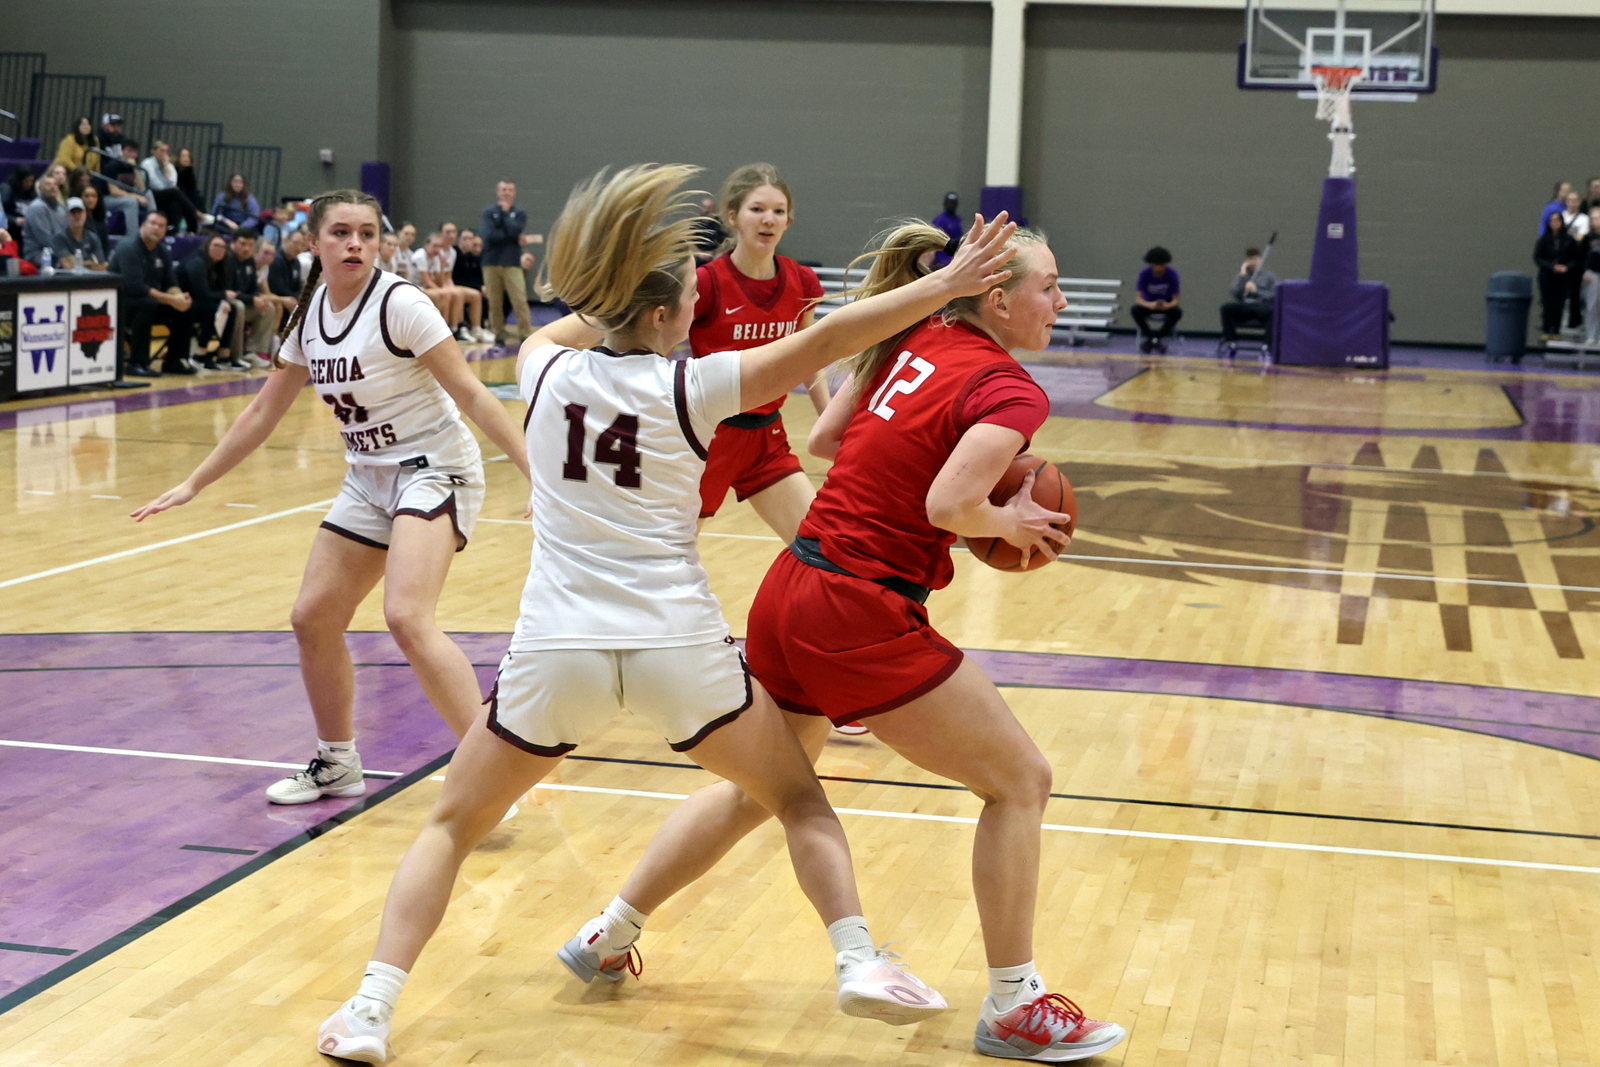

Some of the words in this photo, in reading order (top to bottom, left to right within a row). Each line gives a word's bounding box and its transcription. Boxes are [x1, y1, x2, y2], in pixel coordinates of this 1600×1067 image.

[733, 320, 798, 340] BELLEVUE
[311, 355, 365, 384] GENOA
[867, 350, 936, 421] 12
[340, 423, 398, 452] METS
[562, 401, 642, 490] 14
